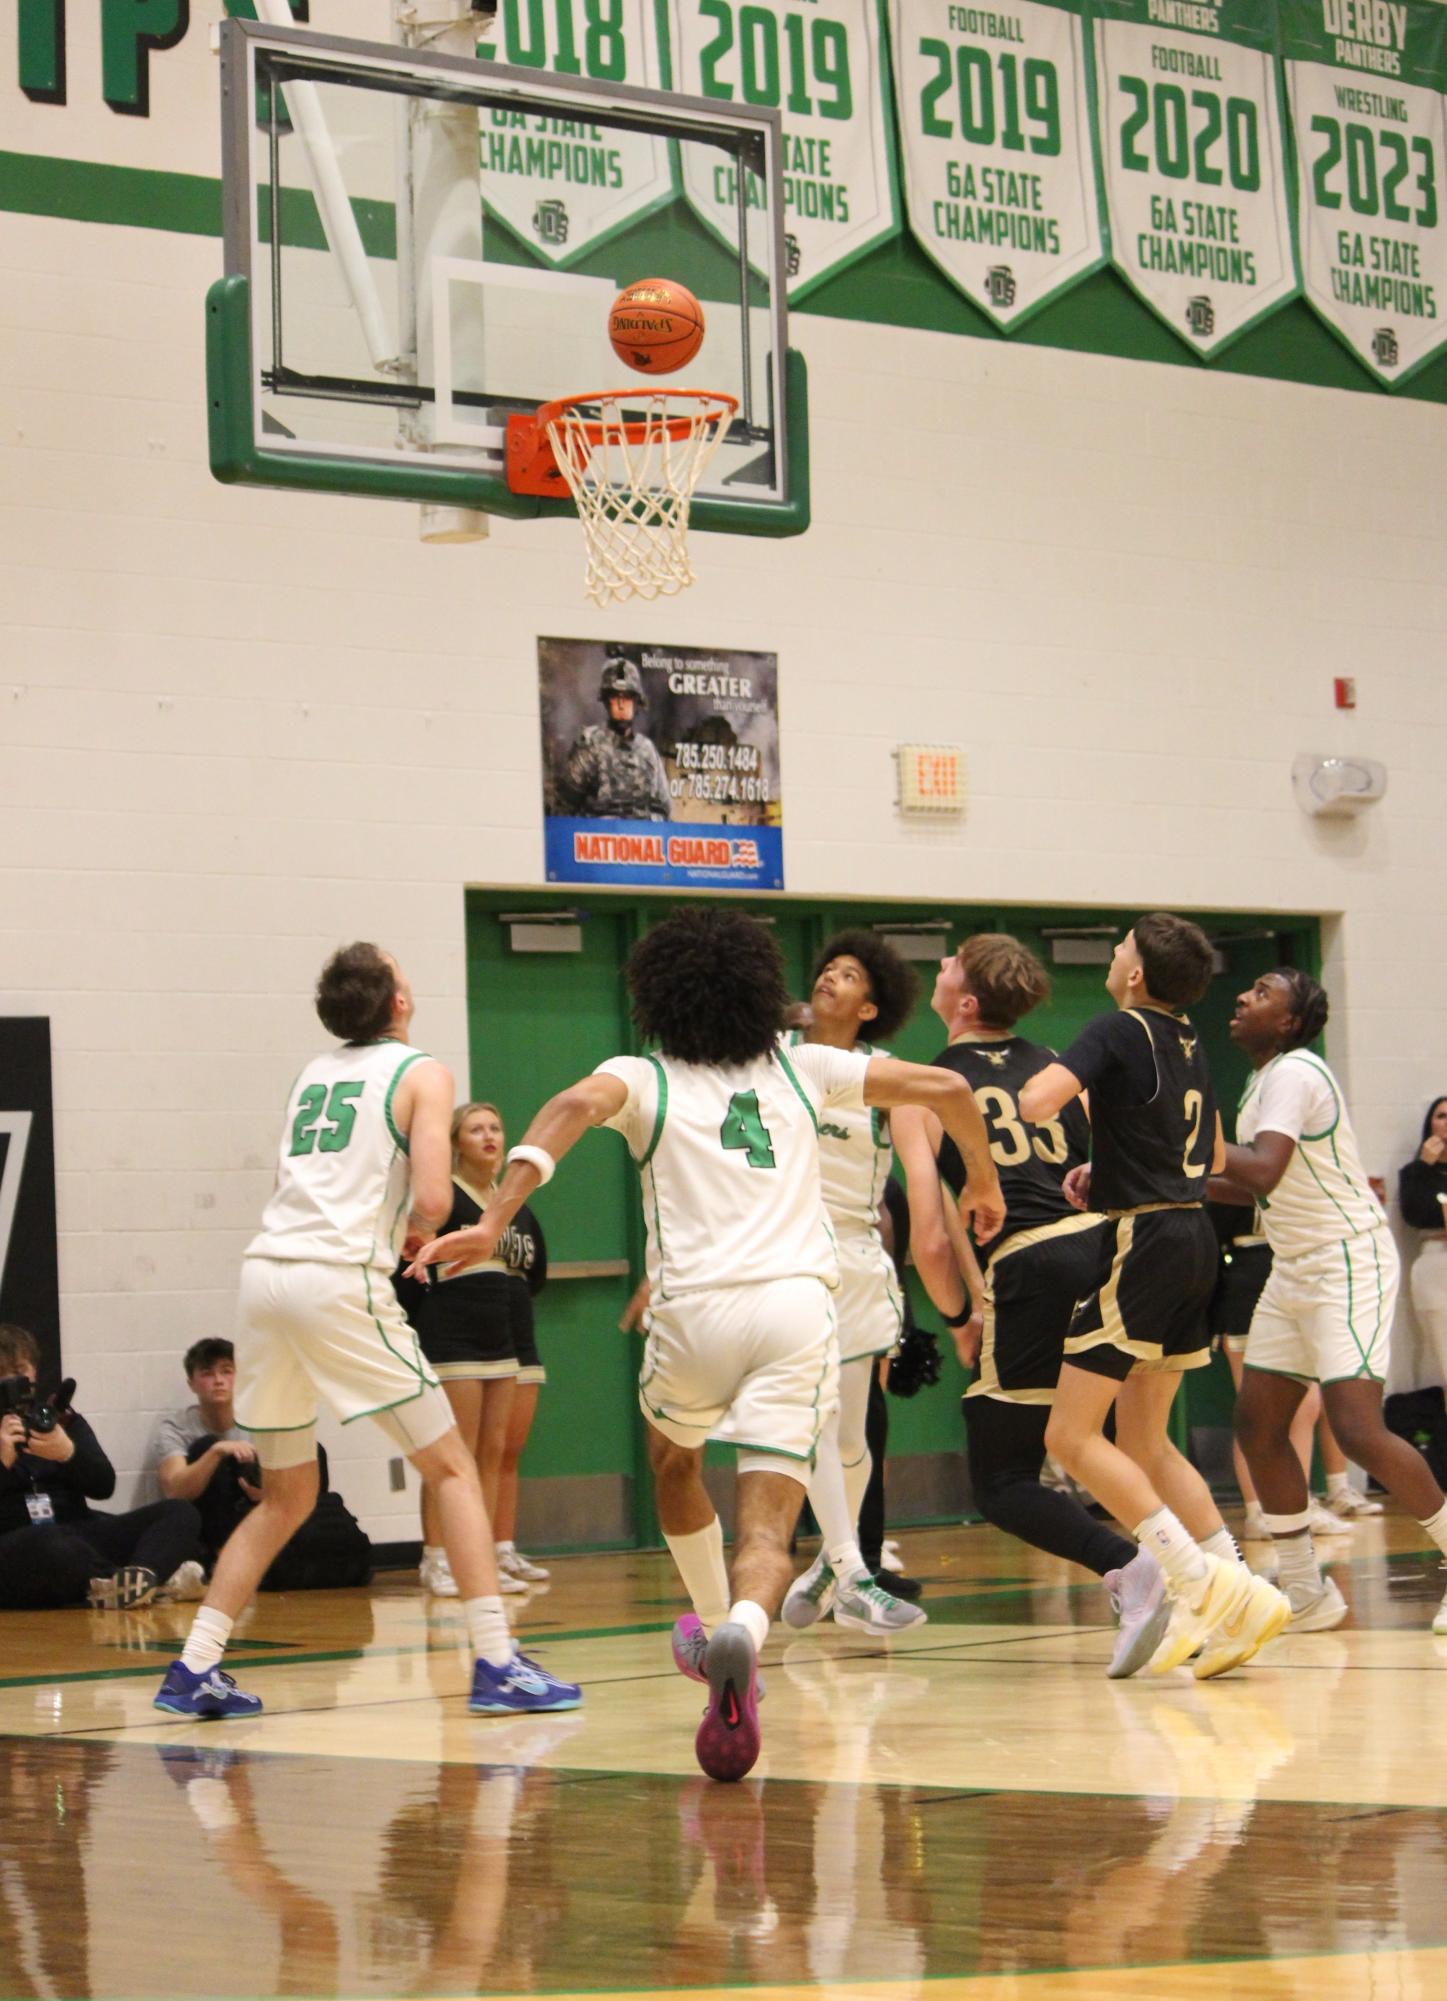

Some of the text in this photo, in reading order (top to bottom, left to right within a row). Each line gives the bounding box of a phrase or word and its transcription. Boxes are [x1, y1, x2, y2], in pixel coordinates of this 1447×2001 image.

[476, 0, 626, 83] 018
[948, 5, 1025, 44] FOOTBALL
[1148, 1, 1219, 34] PANTHERS
[1321, 0, 1408, 51] DERBY
[699, 0, 852, 120] 2019
[1151, 44, 1223, 81] FOOTBALL
[1335, 38, 1401, 75] PANTHERS
[918, 37, 1062, 157] 2019
[1334, 85, 1409, 123] WRESTLING
[782, 133, 832, 178] TATE
[1118, 74, 1261, 193] 2020
[480, 130, 624, 188] CHAMPIONS
[1310, 115, 1438, 229] 2023
[946, 161, 1043, 211] 6A STATE
[933, 201, 1060, 256] CHAMPIONS
[1150, 195, 1239, 244] 6A STATE
[1137, 234, 1256, 286] CHAMPIONS
[1337, 230, 1420, 278] 6A STATE
[1330, 266, 1437, 319] CHAMPIONS
[641, 653, 673, 673] Belong
[674, 658, 684, 670] to
[668, 672, 753, 698] GREATER
[674, 742, 758, 771] 785.250.1484
[670, 773, 769, 802] or 785.274.1618
[574, 832, 731, 868] NATIONAL GUARD
[288, 1081, 365, 1158] 25
[720, 1088, 776, 1169] 4
[973, 1086, 1068, 1167] 33
[1182, 1088, 1206, 1179] 2
